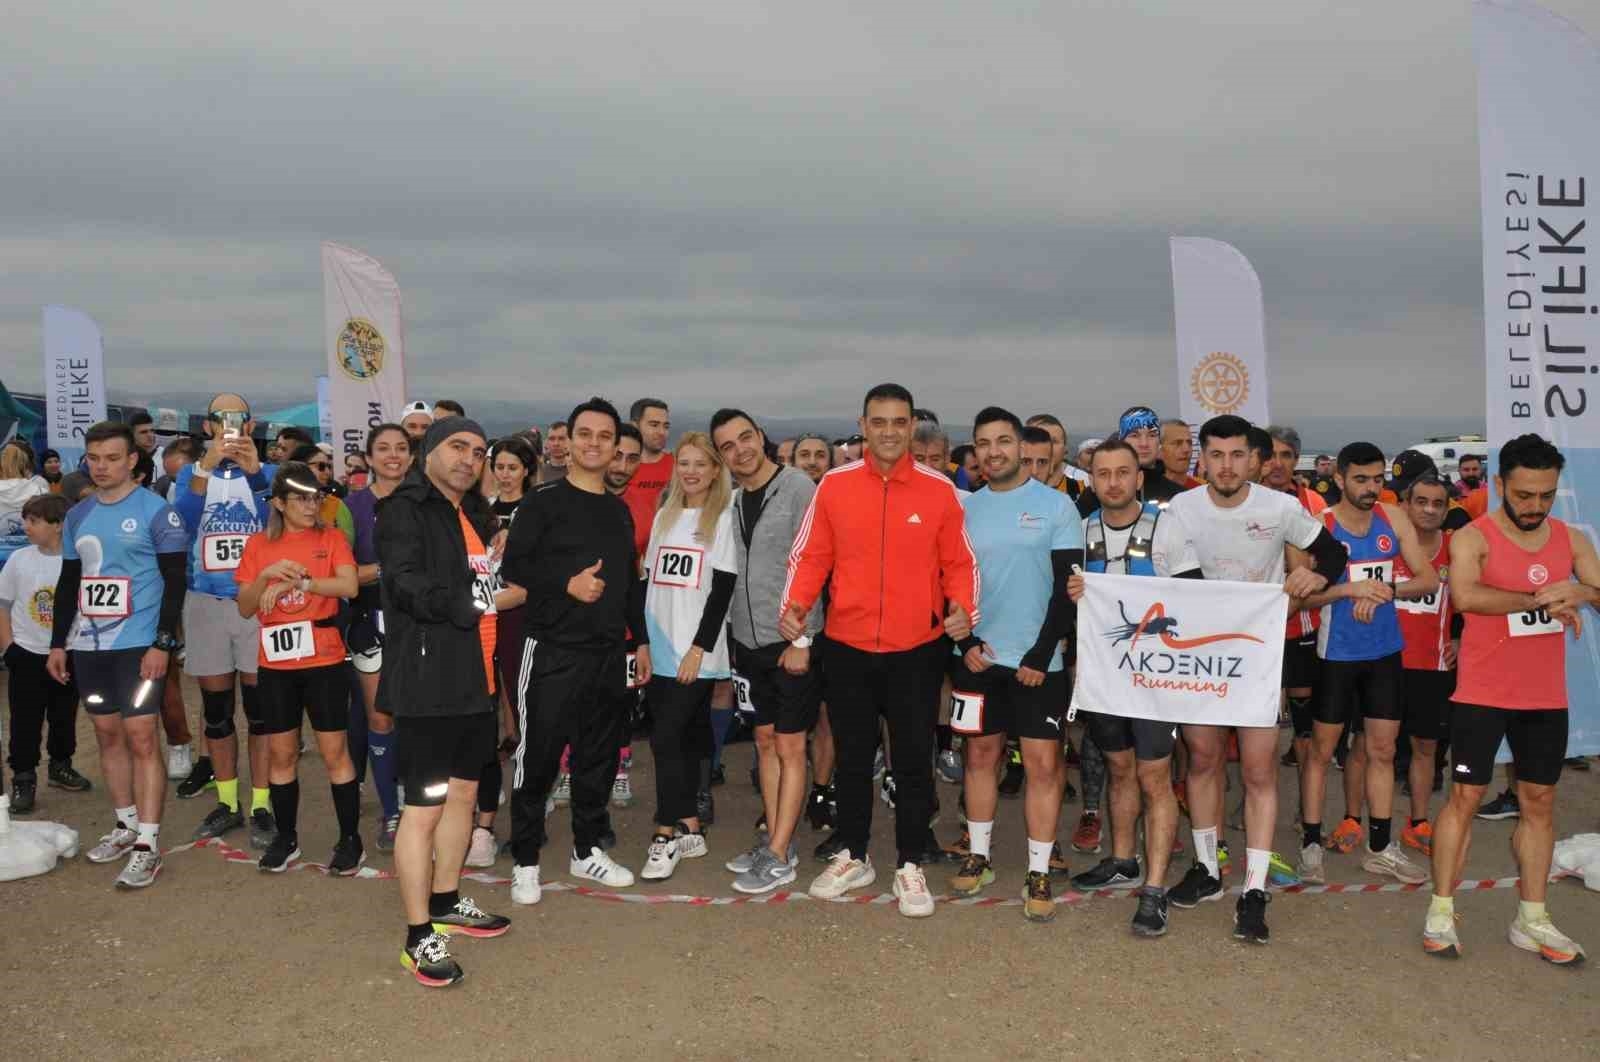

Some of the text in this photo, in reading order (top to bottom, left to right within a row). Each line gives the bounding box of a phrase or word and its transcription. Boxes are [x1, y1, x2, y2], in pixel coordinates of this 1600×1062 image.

[216, 539, 243, 562] 55
[661, 553, 693, 577] 120
[85, 583, 120, 606] 122
[269, 626, 304, 653] 107
[1118, 651, 1243, 679] AKDENİZ
[1132, 672, 1229, 698] Running
